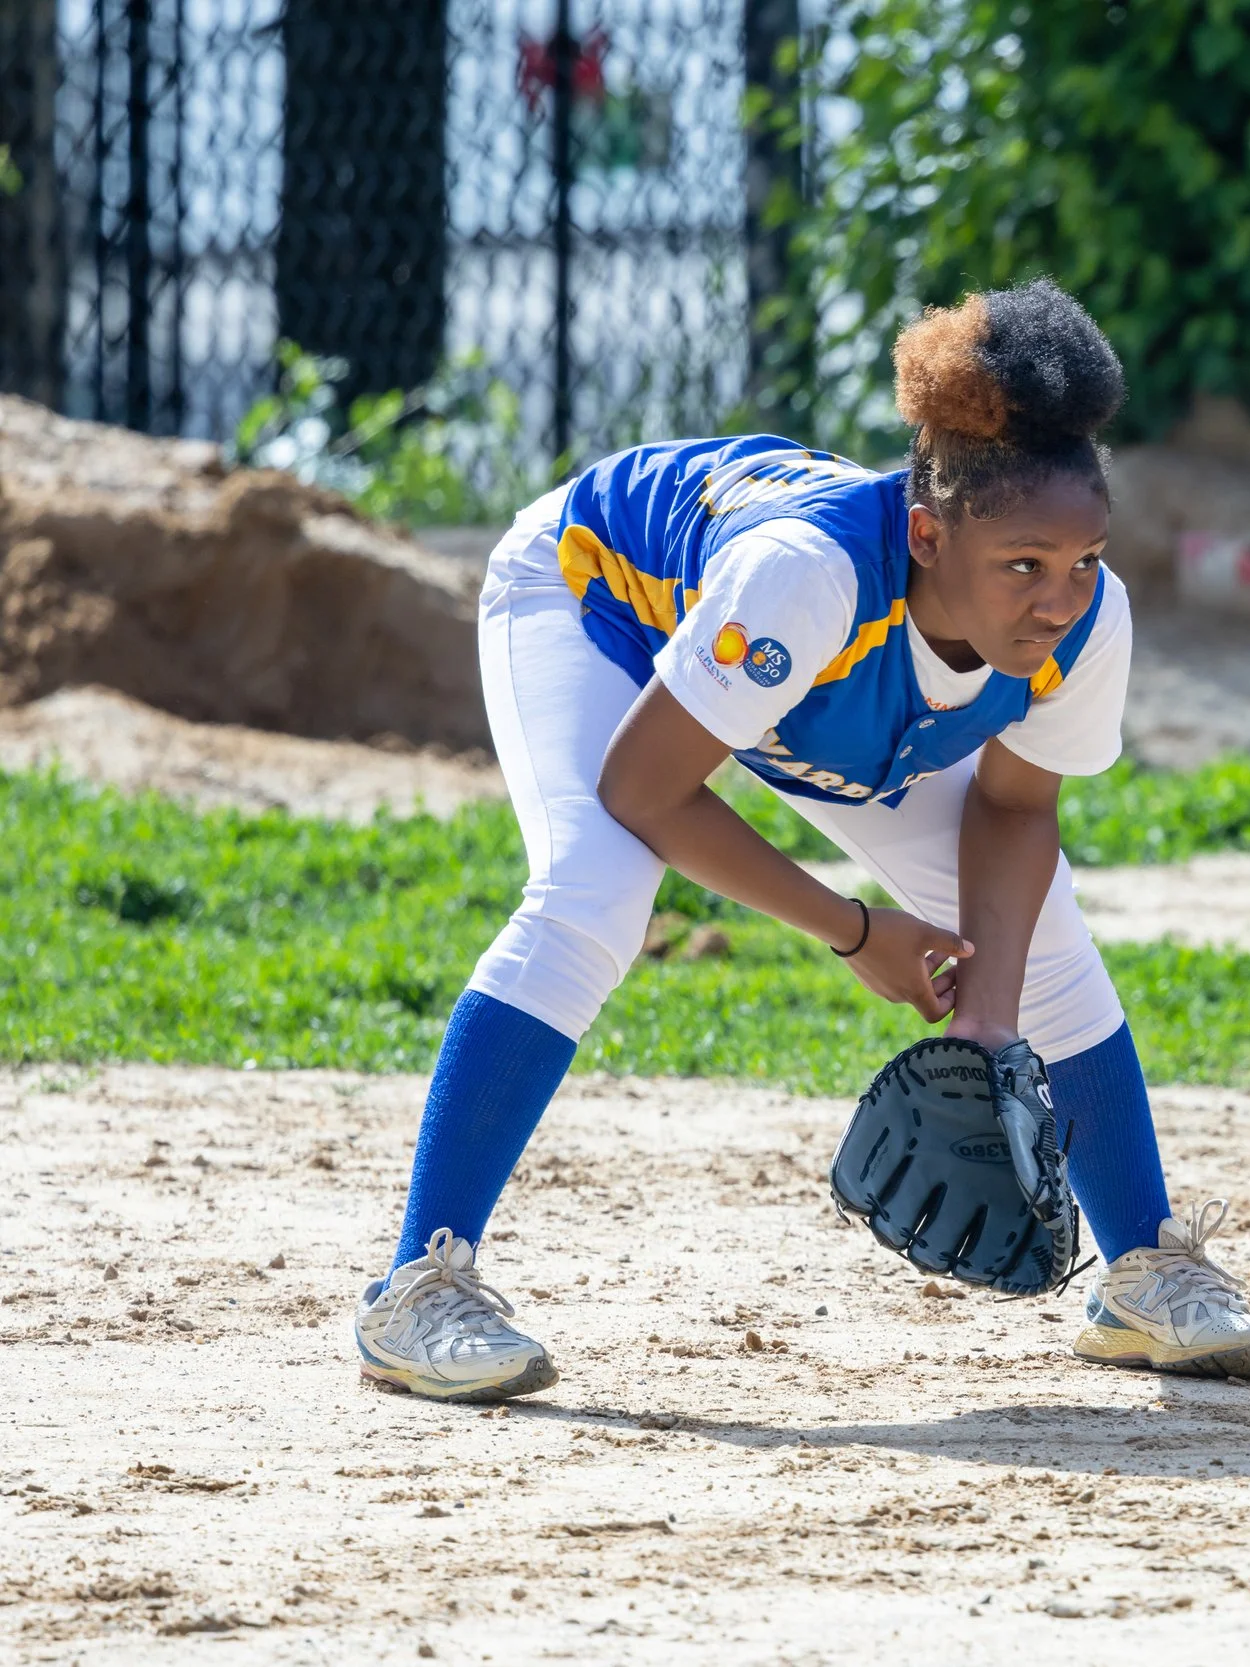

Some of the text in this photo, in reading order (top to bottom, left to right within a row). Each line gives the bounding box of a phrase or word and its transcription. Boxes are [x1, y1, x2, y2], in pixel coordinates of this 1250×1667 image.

[760, 641, 787, 665] MS
[758, 662, 780, 678] 50
[924, 1066, 988, 1082] Wilson
